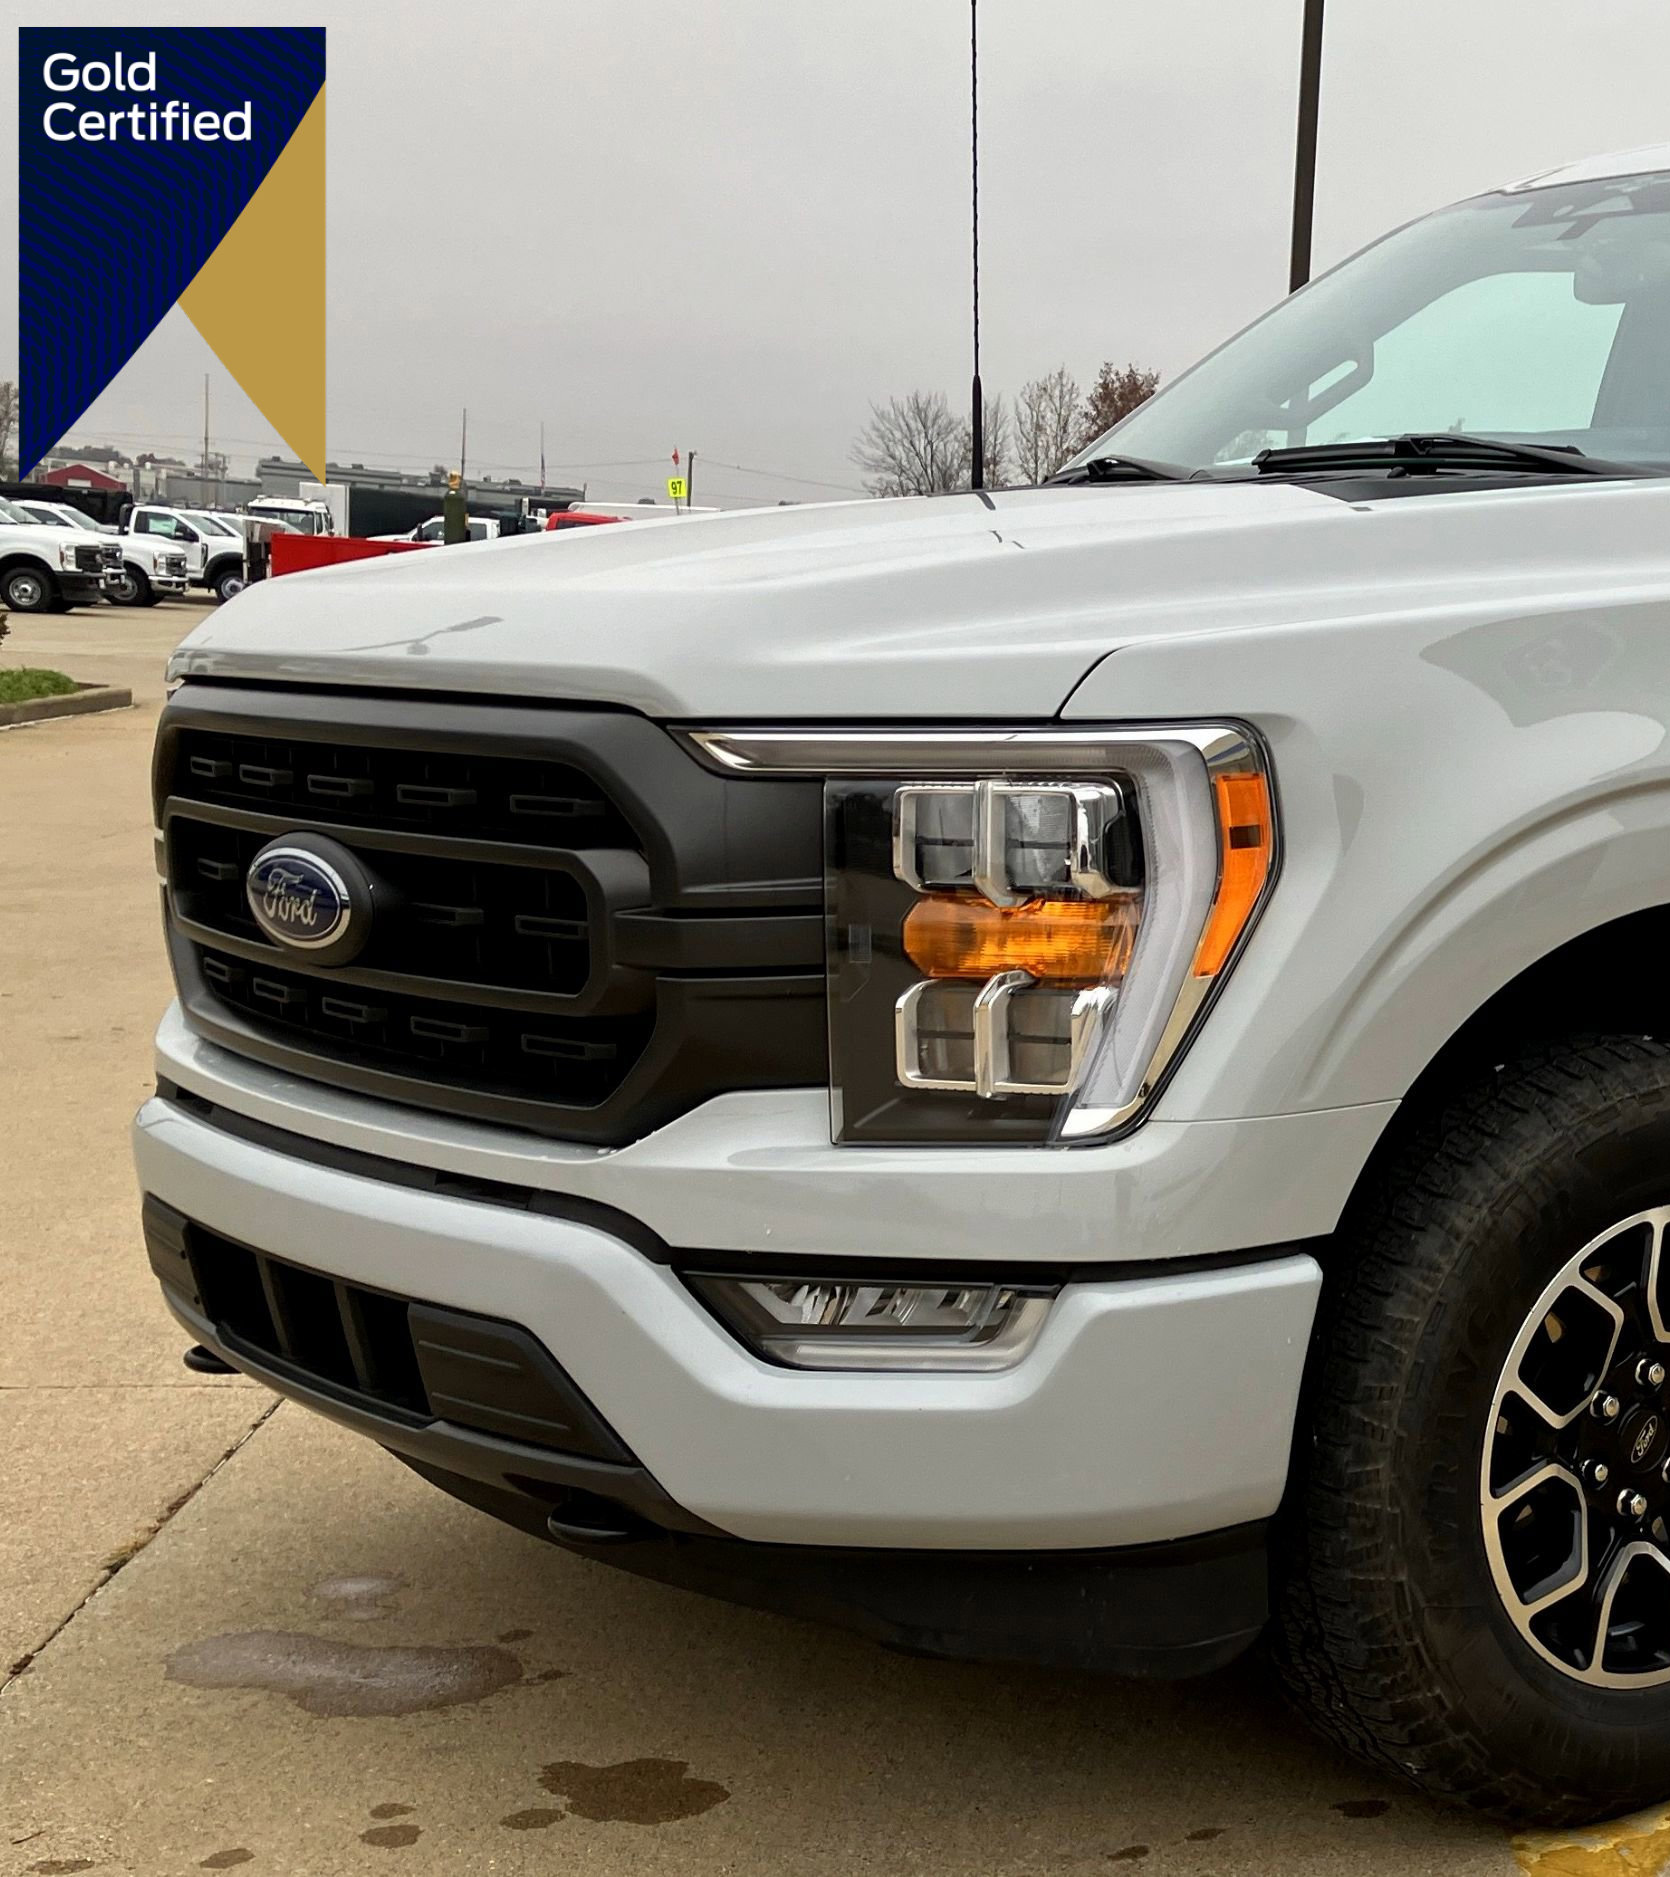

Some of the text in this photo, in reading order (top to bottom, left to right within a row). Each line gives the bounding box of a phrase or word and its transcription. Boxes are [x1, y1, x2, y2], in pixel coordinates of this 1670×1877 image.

[671, 480, 682, 495] 97
[263, 867, 318, 926] Ford
[1635, 1422, 1655, 1456] Ford
